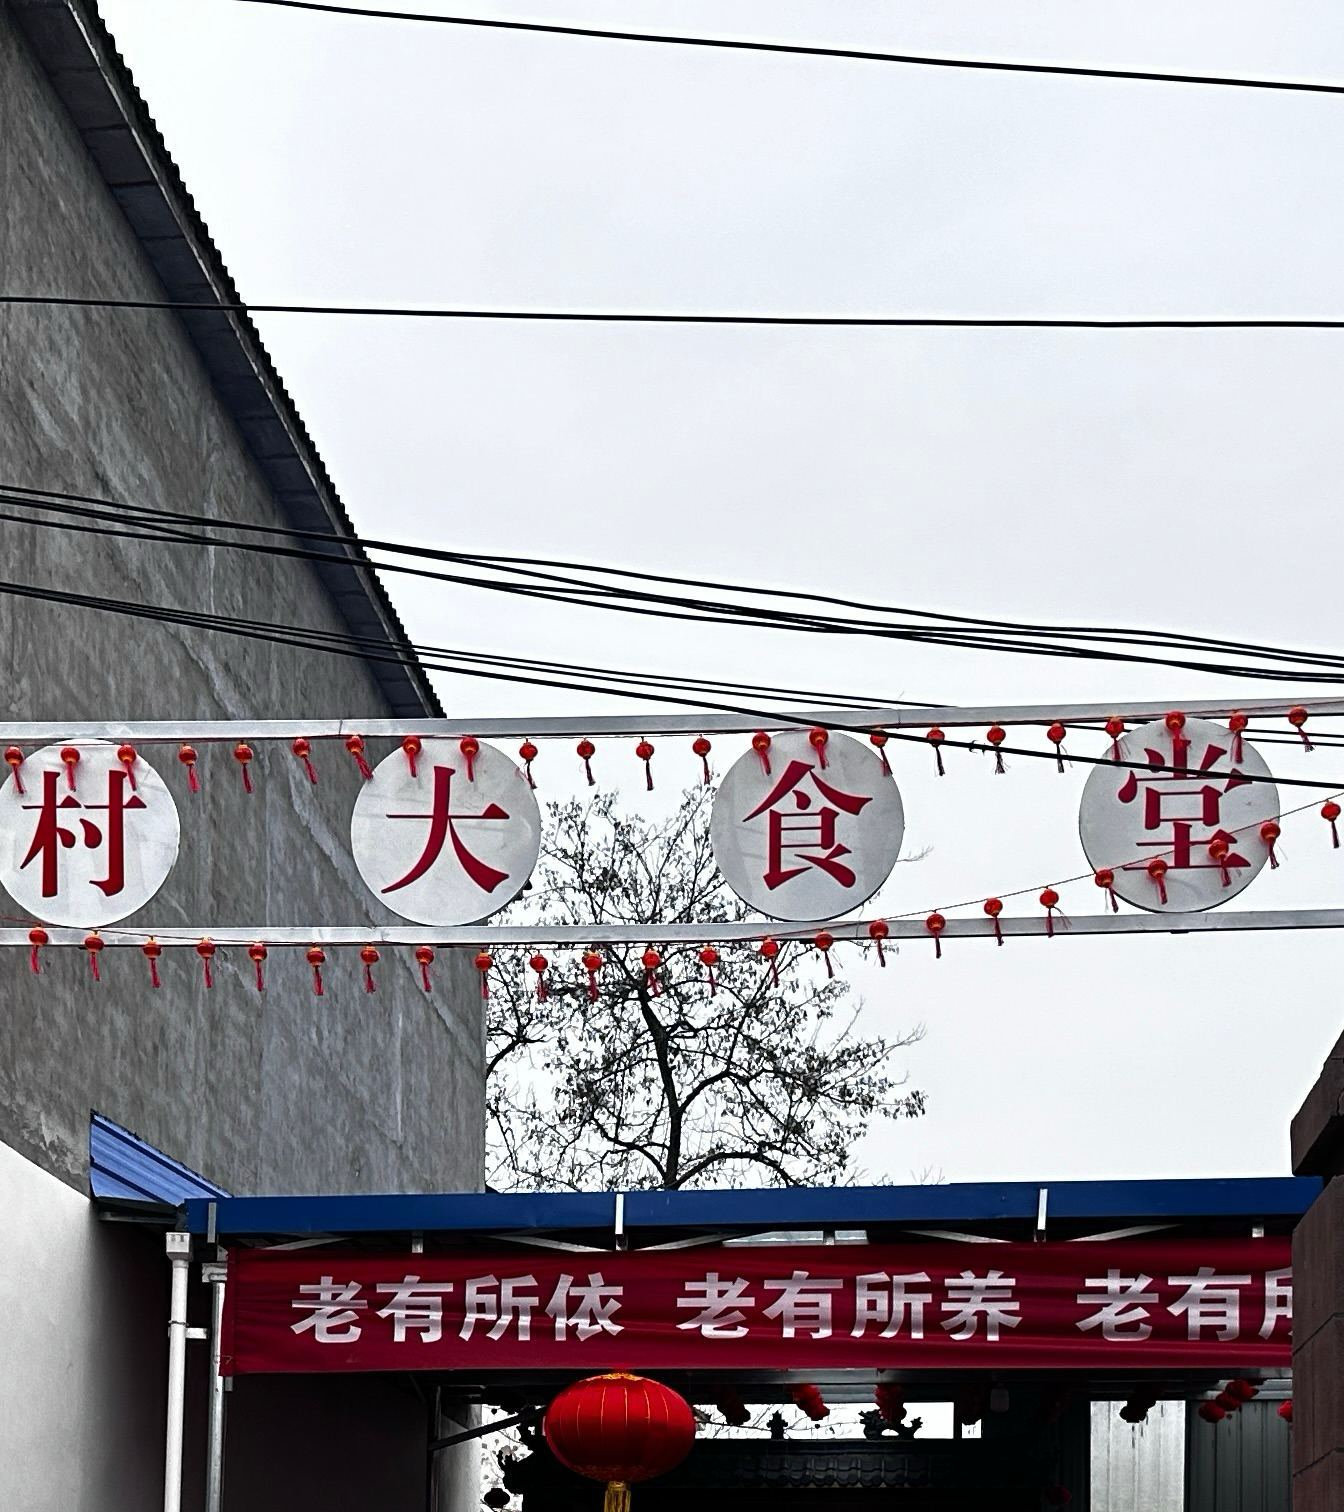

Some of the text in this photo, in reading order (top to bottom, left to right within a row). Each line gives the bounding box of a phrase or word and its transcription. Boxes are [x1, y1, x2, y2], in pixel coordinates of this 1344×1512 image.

[290, 1274, 624, 1345] 老有所依
[676, 1269, 1022, 1342] 老有所养
